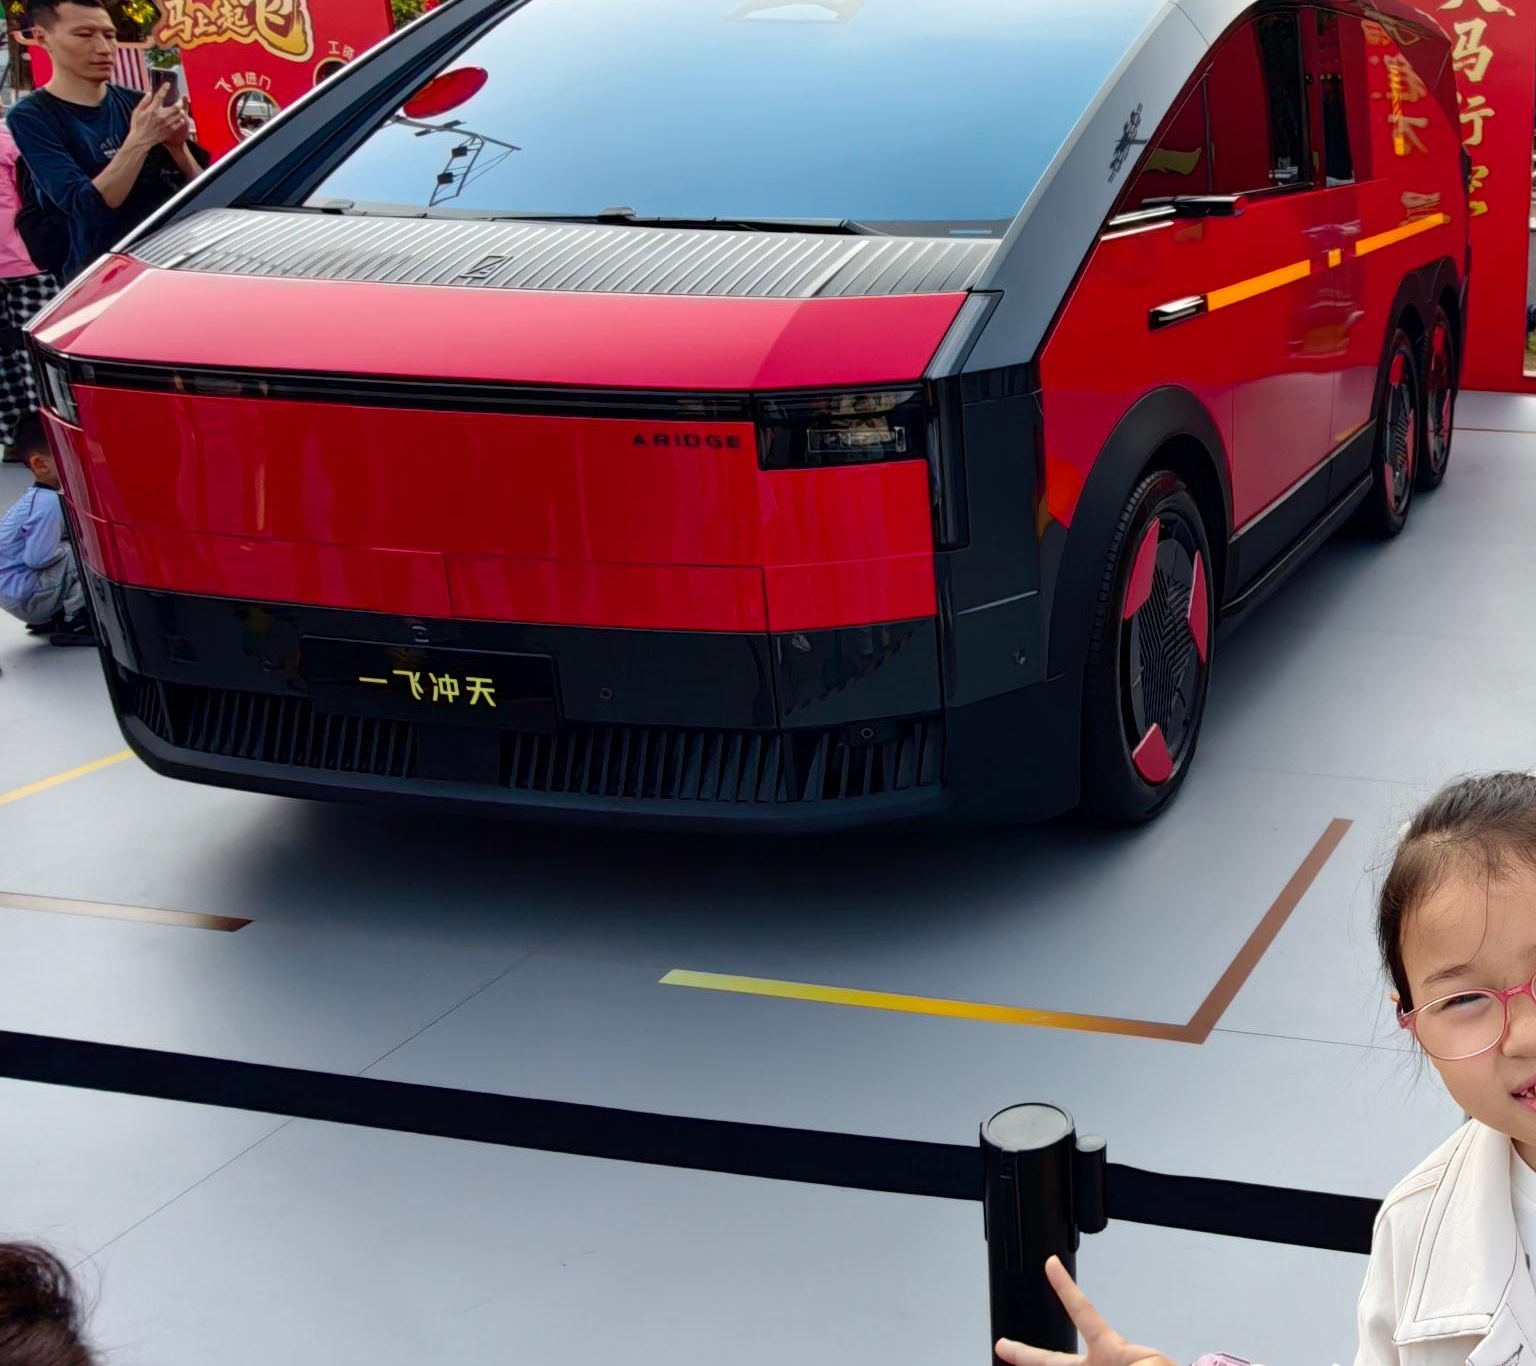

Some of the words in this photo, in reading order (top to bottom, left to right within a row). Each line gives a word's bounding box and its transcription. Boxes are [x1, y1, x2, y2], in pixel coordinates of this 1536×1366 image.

[632, 433, 742, 448] ARIDGE
[358, 669, 497, 707] 一飞冲天
